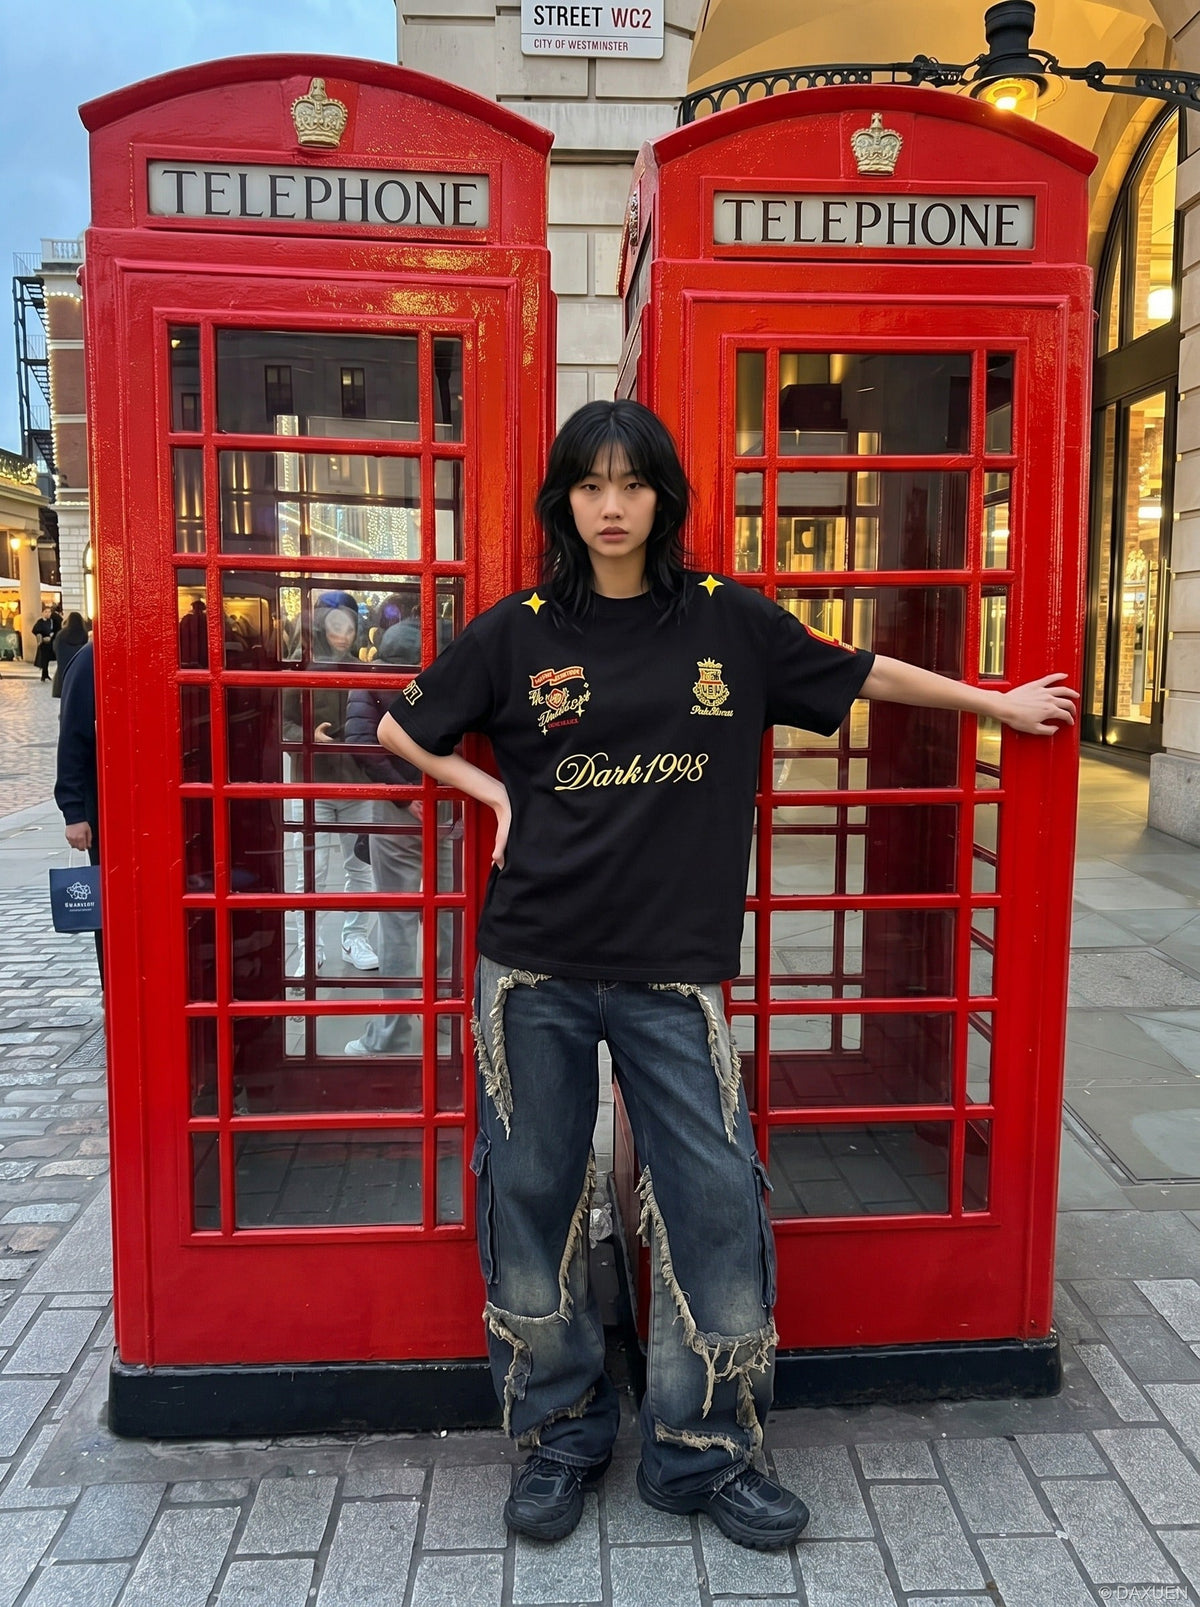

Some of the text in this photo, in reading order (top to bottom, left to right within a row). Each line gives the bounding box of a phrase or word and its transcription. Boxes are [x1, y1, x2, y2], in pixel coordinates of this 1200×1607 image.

[534, 5, 652, 29] STREET WC2
[534, 39, 629, 51] CITY OF WESTMINSTER
[161, 169, 478, 227] TELEPHONE
[721, 198, 1020, 247] TELEPHONE
[554, 752, 709, 791] Dark1998
